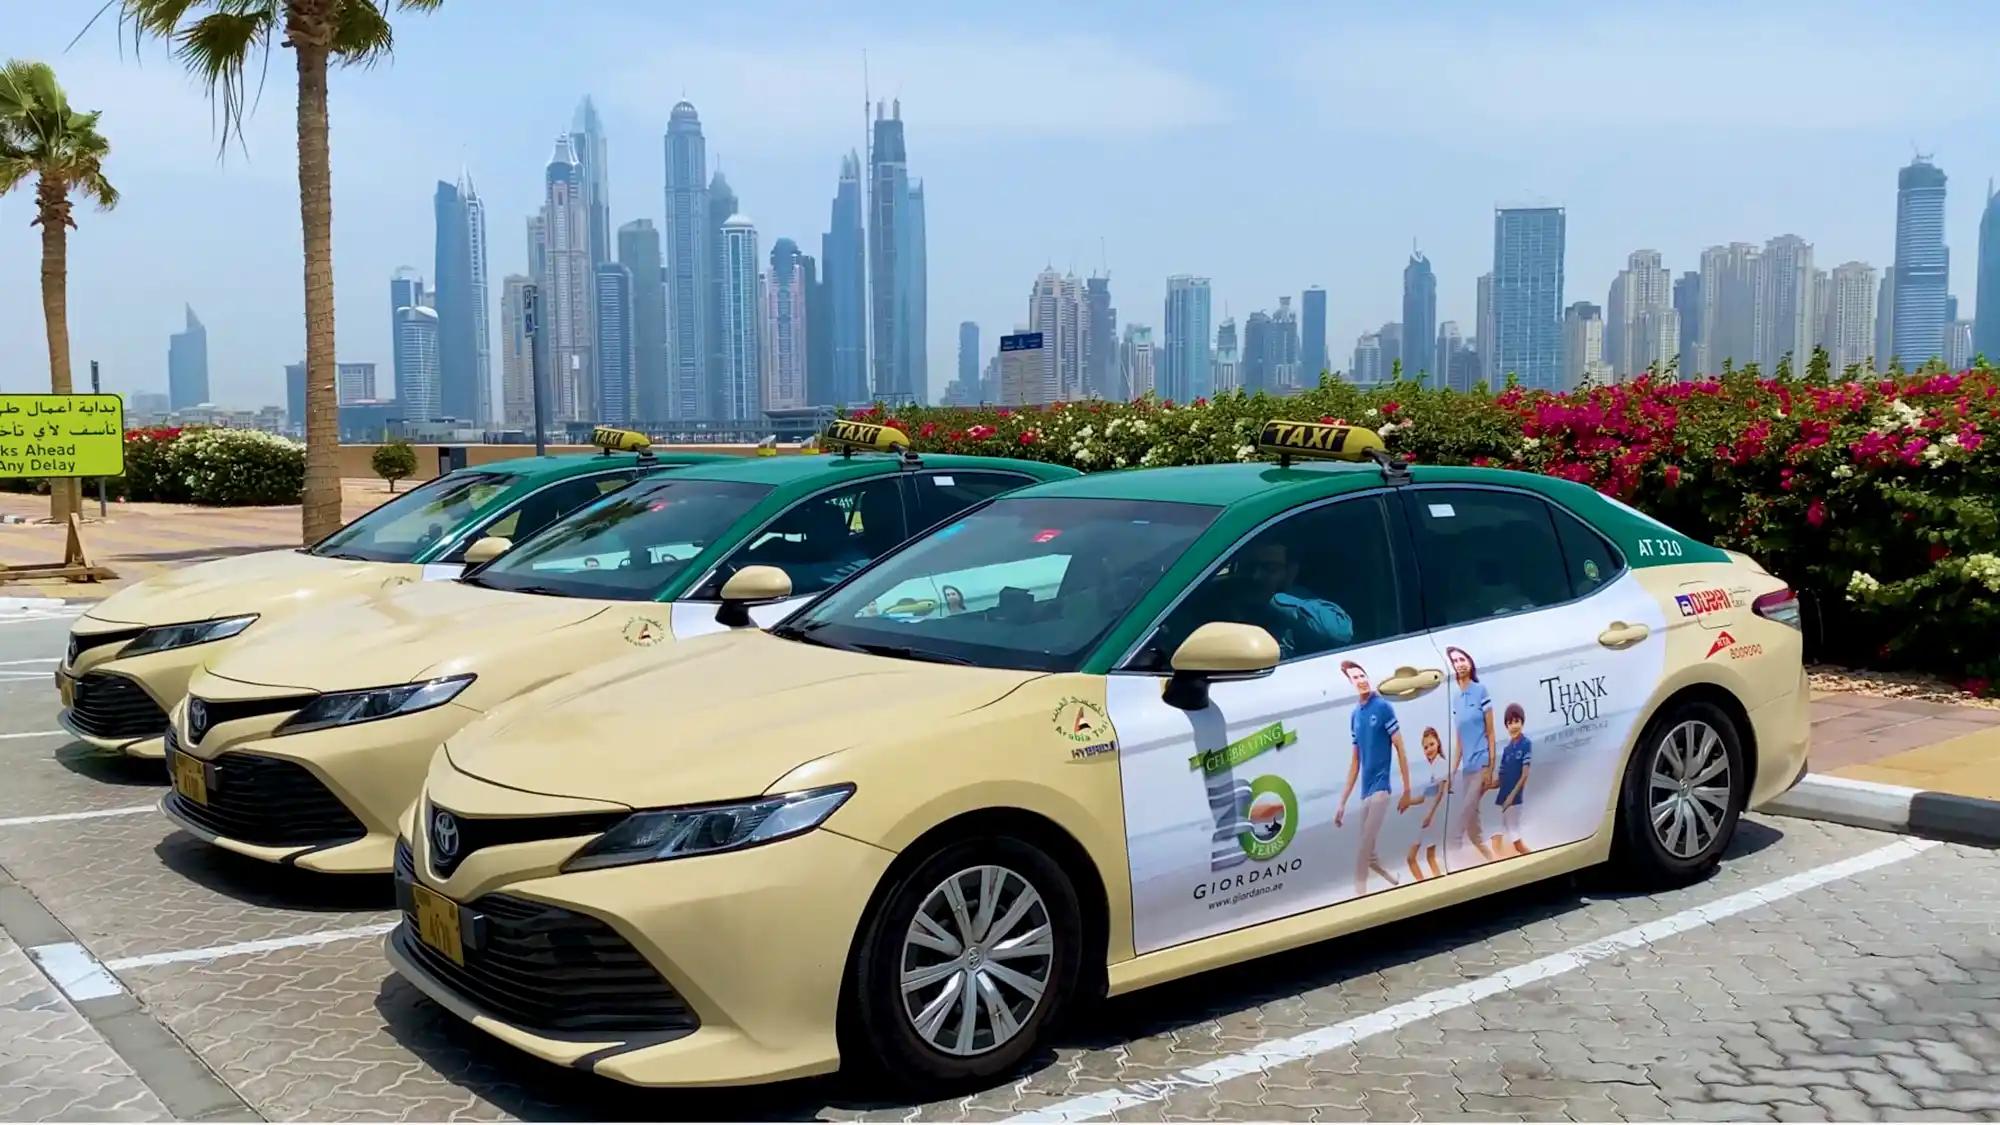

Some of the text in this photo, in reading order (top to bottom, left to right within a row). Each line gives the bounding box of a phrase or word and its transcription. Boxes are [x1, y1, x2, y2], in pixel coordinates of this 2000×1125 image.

[27, 398, 72, 417] أعمال
[79, 401, 116, 416] بداية
[594, 431, 621, 445] TAXI
[832, 423, 875, 442] TAXI
[1275, 424, 1339, 450] TAXI
[25, 444, 76, 456] Ahead
[31, 458, 76, 472] Delay
[1638, 539, 1683, 556] AT 320
[1688, 588, 1731, 613] DUBAI
[1538, 675, 1609, 714] THANK
[1560, 698, 1600, 727] YOU
[1206, 725, 1282, 772] CELEBRATING
[1250, 836, 1284, 857] YEARS
[1192, 857, 1303, 901] GIORDANO
[1207, 881, 1285, 911] www.giordano.ae
